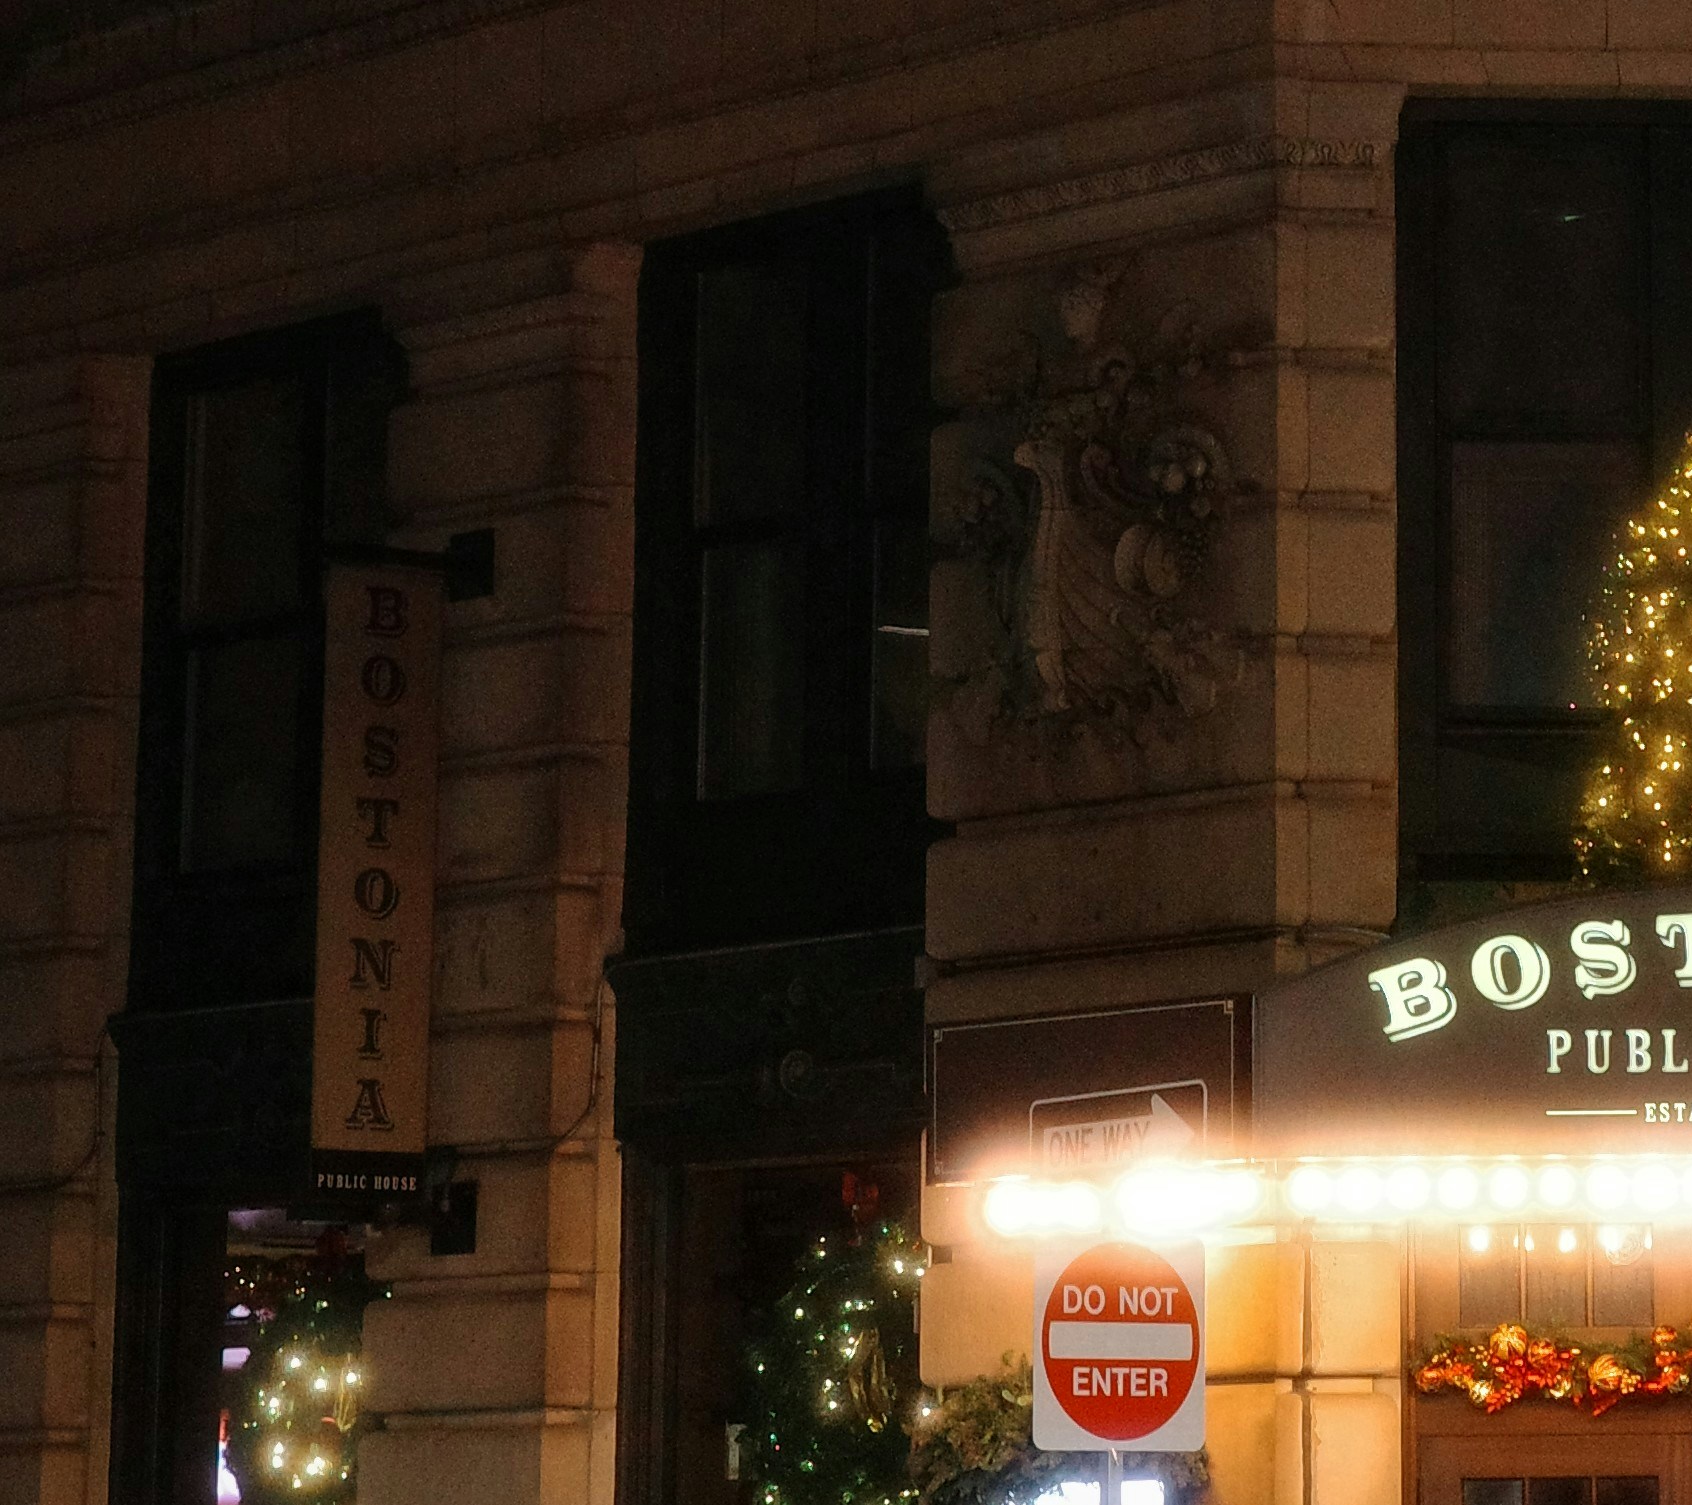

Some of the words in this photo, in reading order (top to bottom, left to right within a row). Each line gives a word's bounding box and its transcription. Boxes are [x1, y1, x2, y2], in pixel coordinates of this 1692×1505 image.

[346, 586, 408, 1131] BOSTONIA
[1049, 1126, 1093, 1166] ONE
[1103, 1120, 1151, 1162] WAY
[317, 1173, 368, 1189] PUBLIC
[374, 1175, 417, 1191] HOUSE
[1062, 1284, 1106, 1315] DO
[1118, 1286, 1178, 1316] NOT
[1072, 1366, 1169, 1396] ENTER
